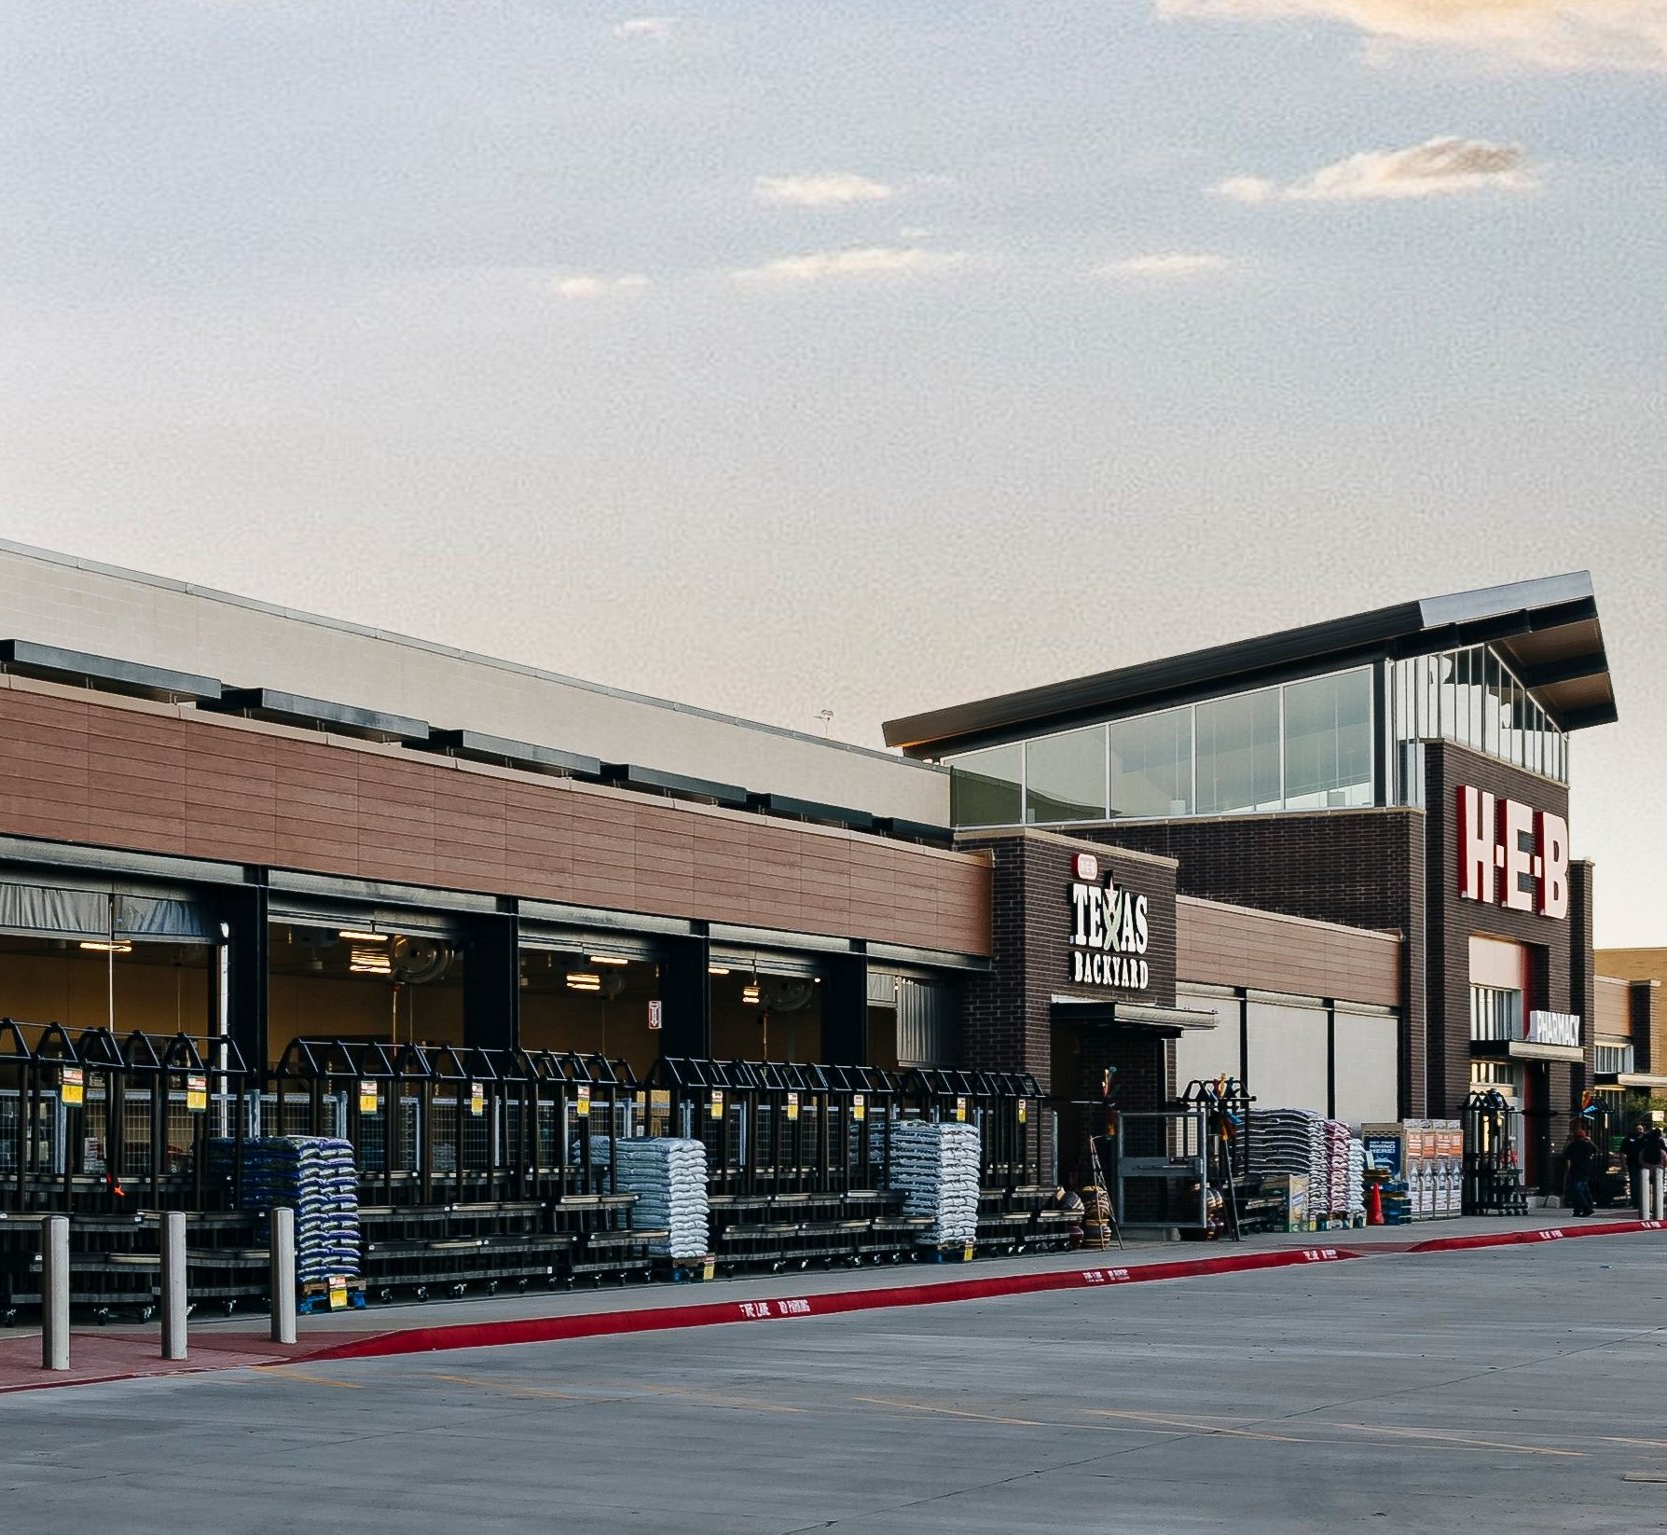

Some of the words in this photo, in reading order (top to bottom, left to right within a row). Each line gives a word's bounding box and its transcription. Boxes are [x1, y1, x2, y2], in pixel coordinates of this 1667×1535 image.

[1071, 877, 1149, 954] TEXAS
[1074, 951, 1149, 989] BACKYARD
[1530, 1010, 1580, 1047] PHARMACY
